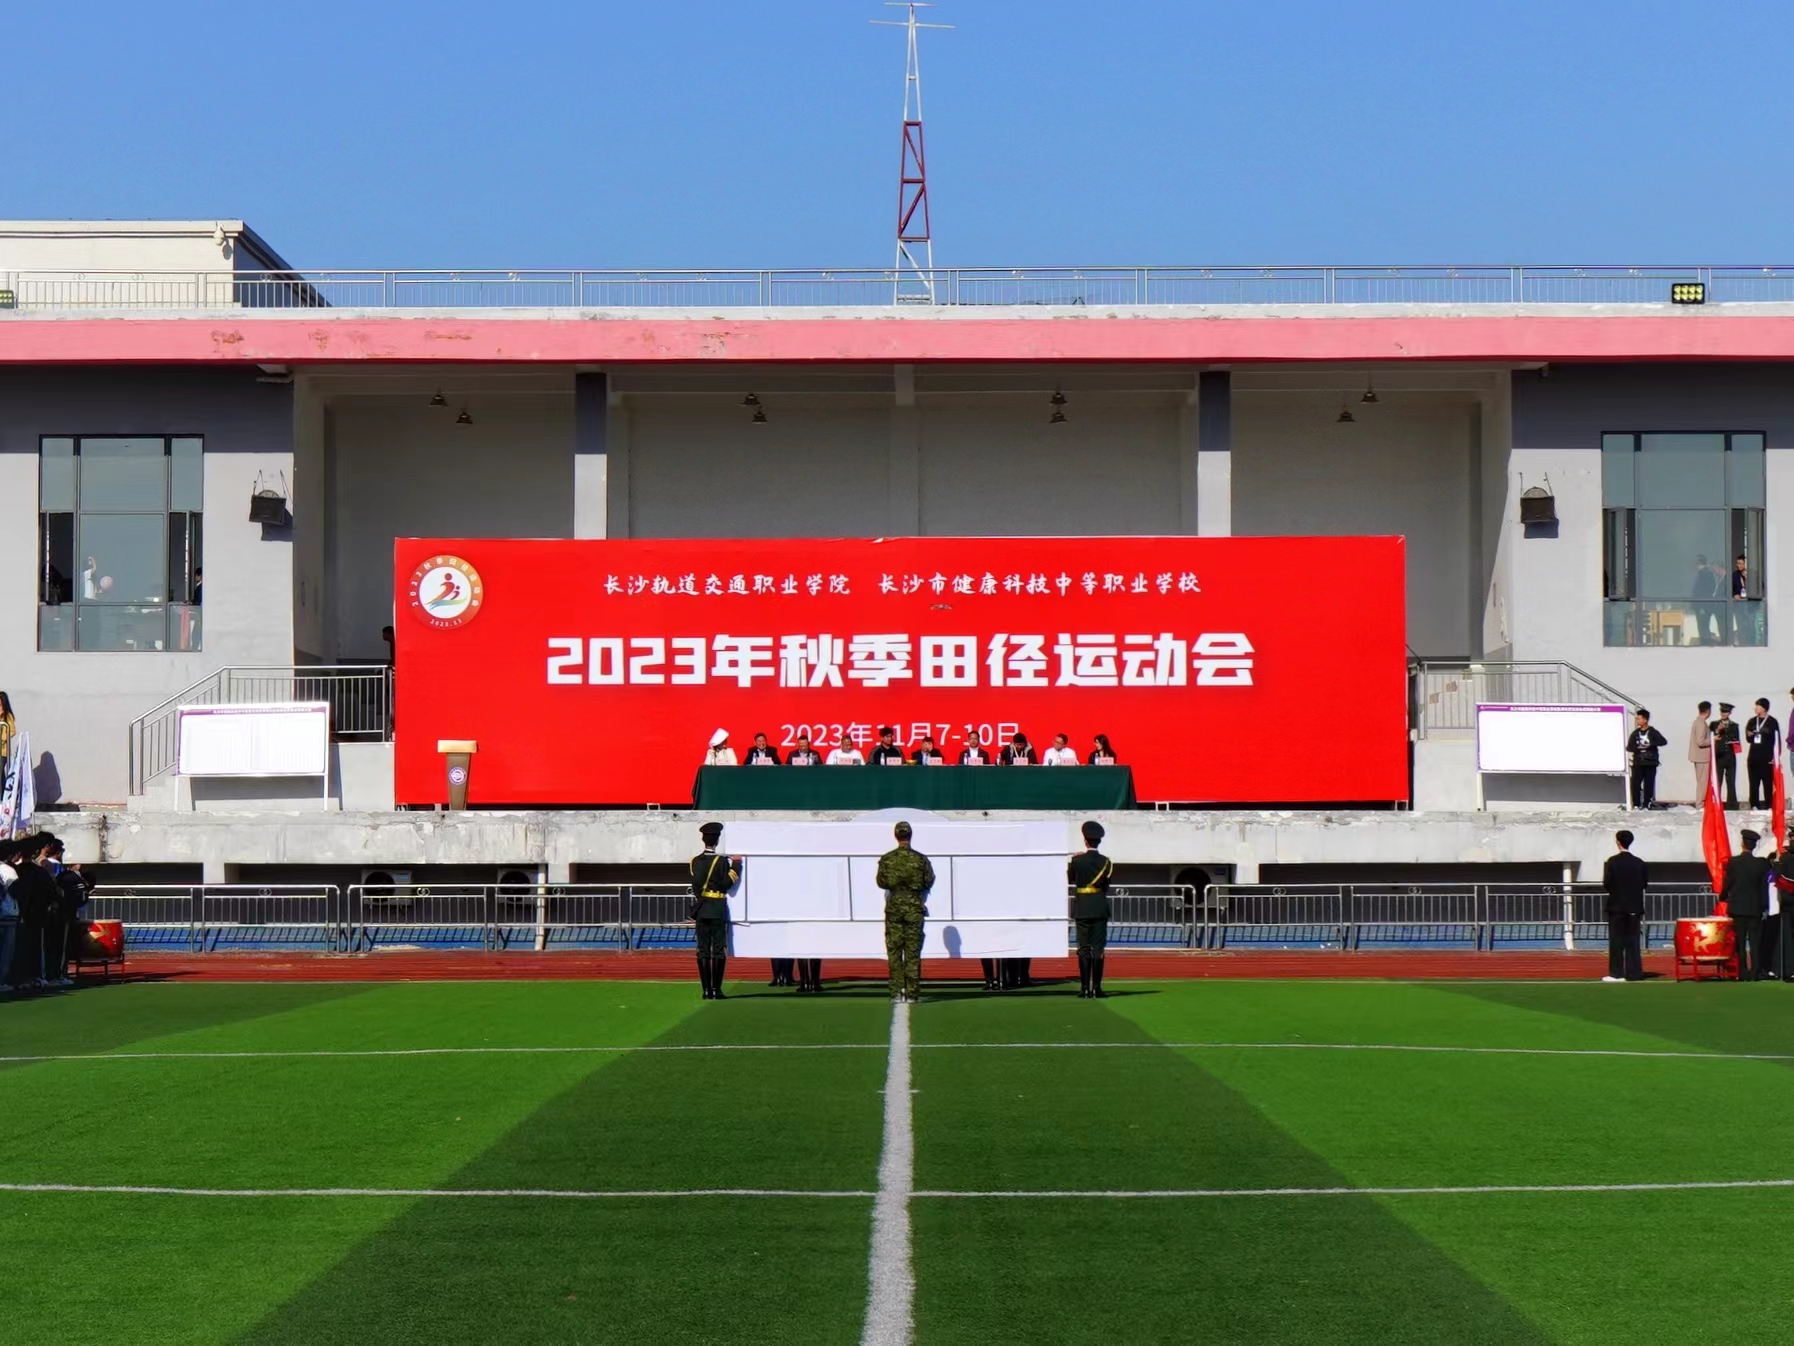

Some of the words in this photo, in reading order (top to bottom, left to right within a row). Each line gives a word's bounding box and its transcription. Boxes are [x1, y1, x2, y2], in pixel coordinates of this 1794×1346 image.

[603, 573, 851, 597] 长沙轨道交通职业学院
[877, 571, 1202, 596] 长沙市健康科技中等职业学校
[547, 632, 1256, 689] 2023年秋季田径运动会
